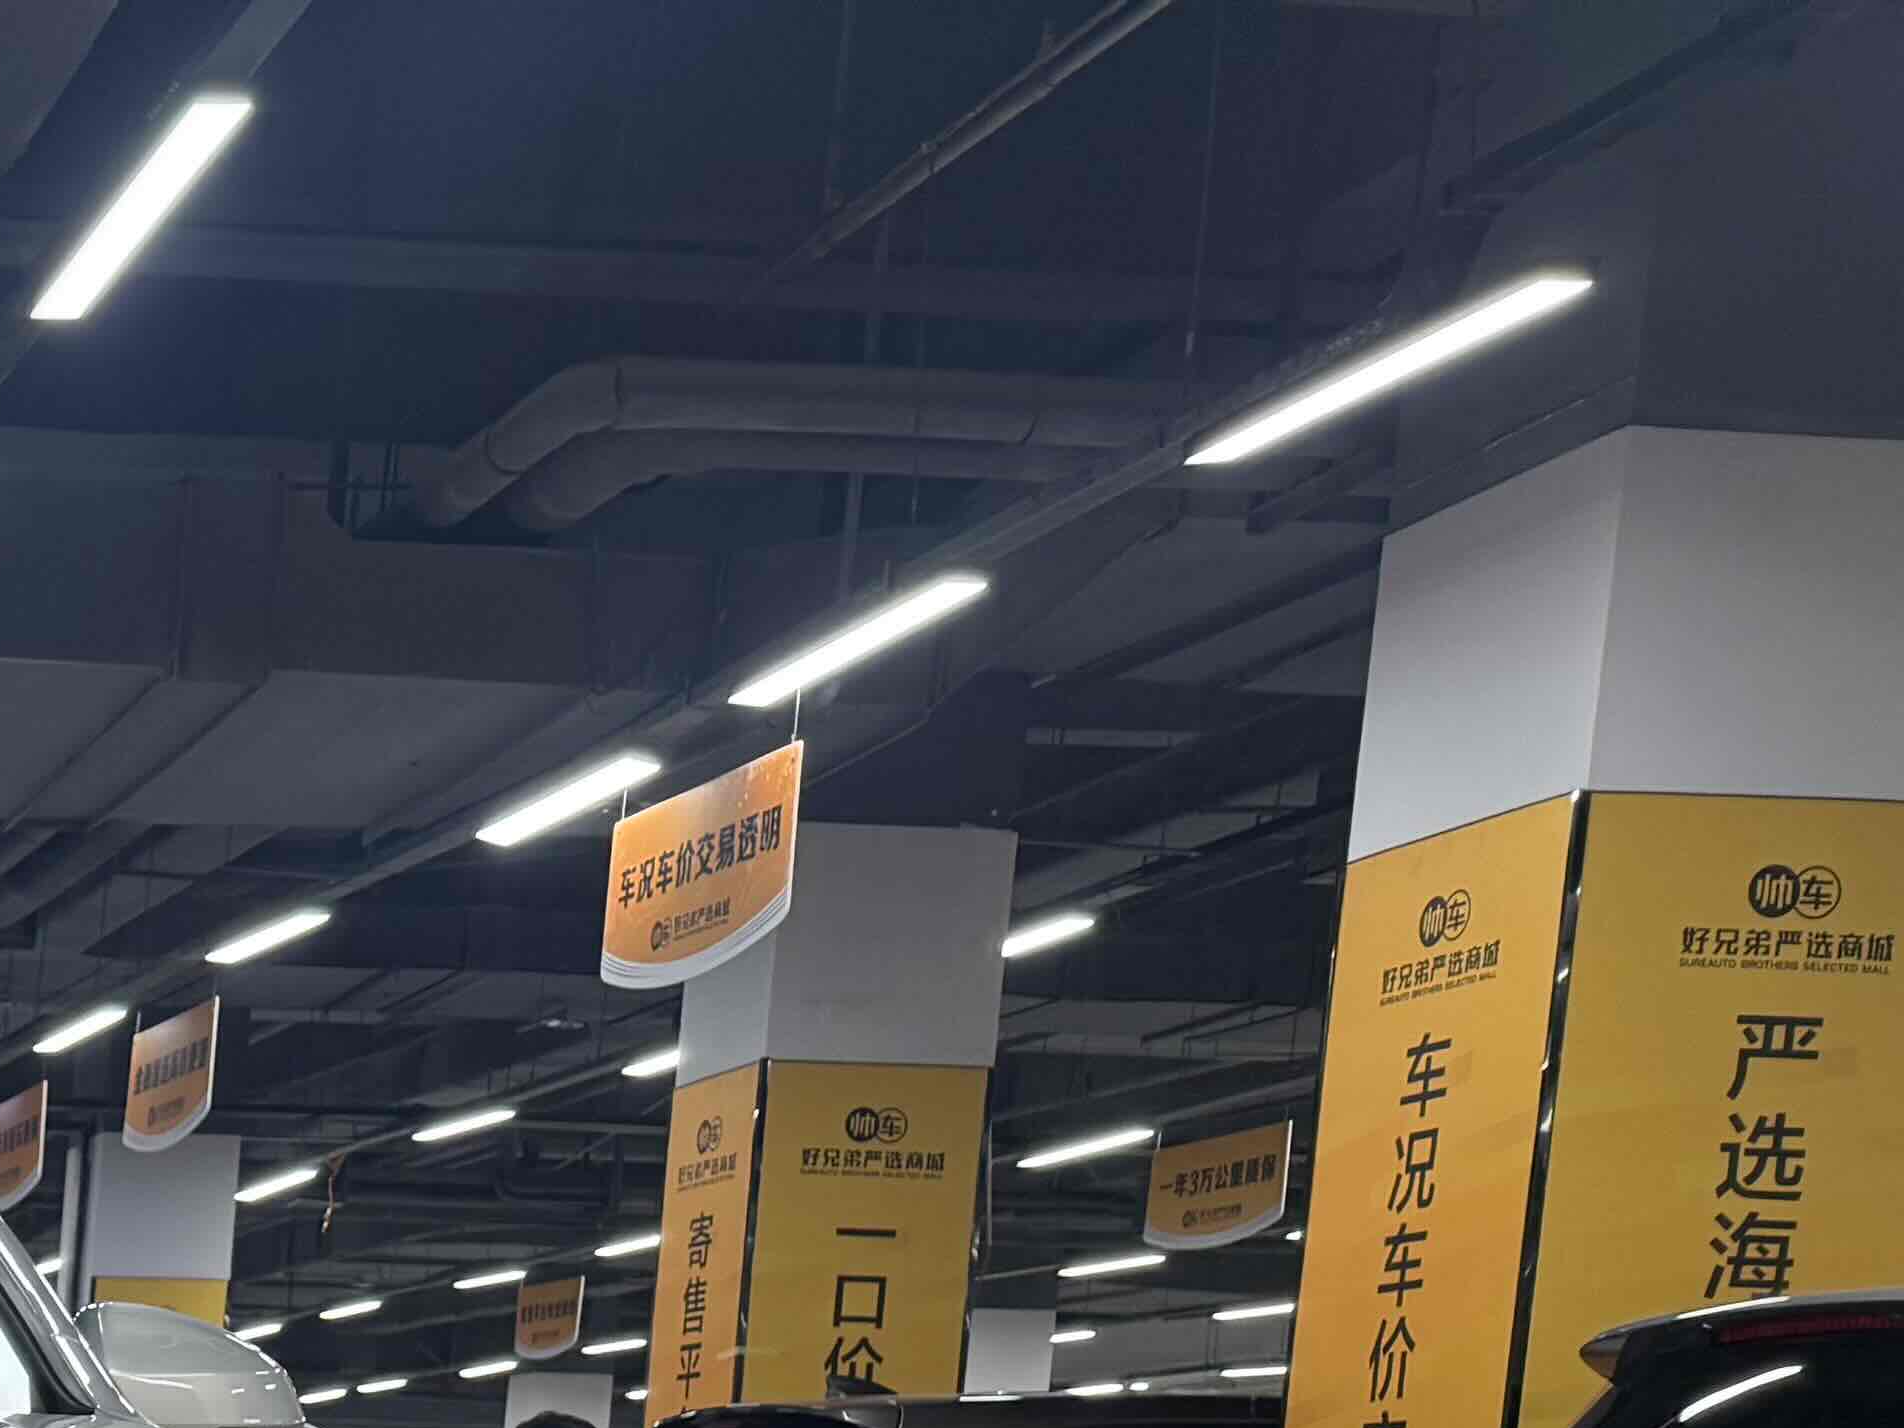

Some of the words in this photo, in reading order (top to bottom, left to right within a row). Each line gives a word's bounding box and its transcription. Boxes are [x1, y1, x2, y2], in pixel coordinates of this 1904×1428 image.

[618, 804, 783, 909] 车况车价交易透明
[1380, 938, 1501, 995] 好兄弟严选商城
[1682, 926, 1895, 962] 好兄弟严选商城
[1741, 958, 1799, 972] BROTHERS
[1803, 960, 1858, 974] SELECTED
[1862, 963, 1890, 976] MALL
[801, 1148, 945, 1172] 好兄弟严选商城
[1159, 1154, 1277, 1198] 一年3万公里质保
[1704, 1014, 1825, 1299] 严选海
[676, 1211, 714, 1417] 寄售平
[824, 1227, 897, 1383] 一口价
